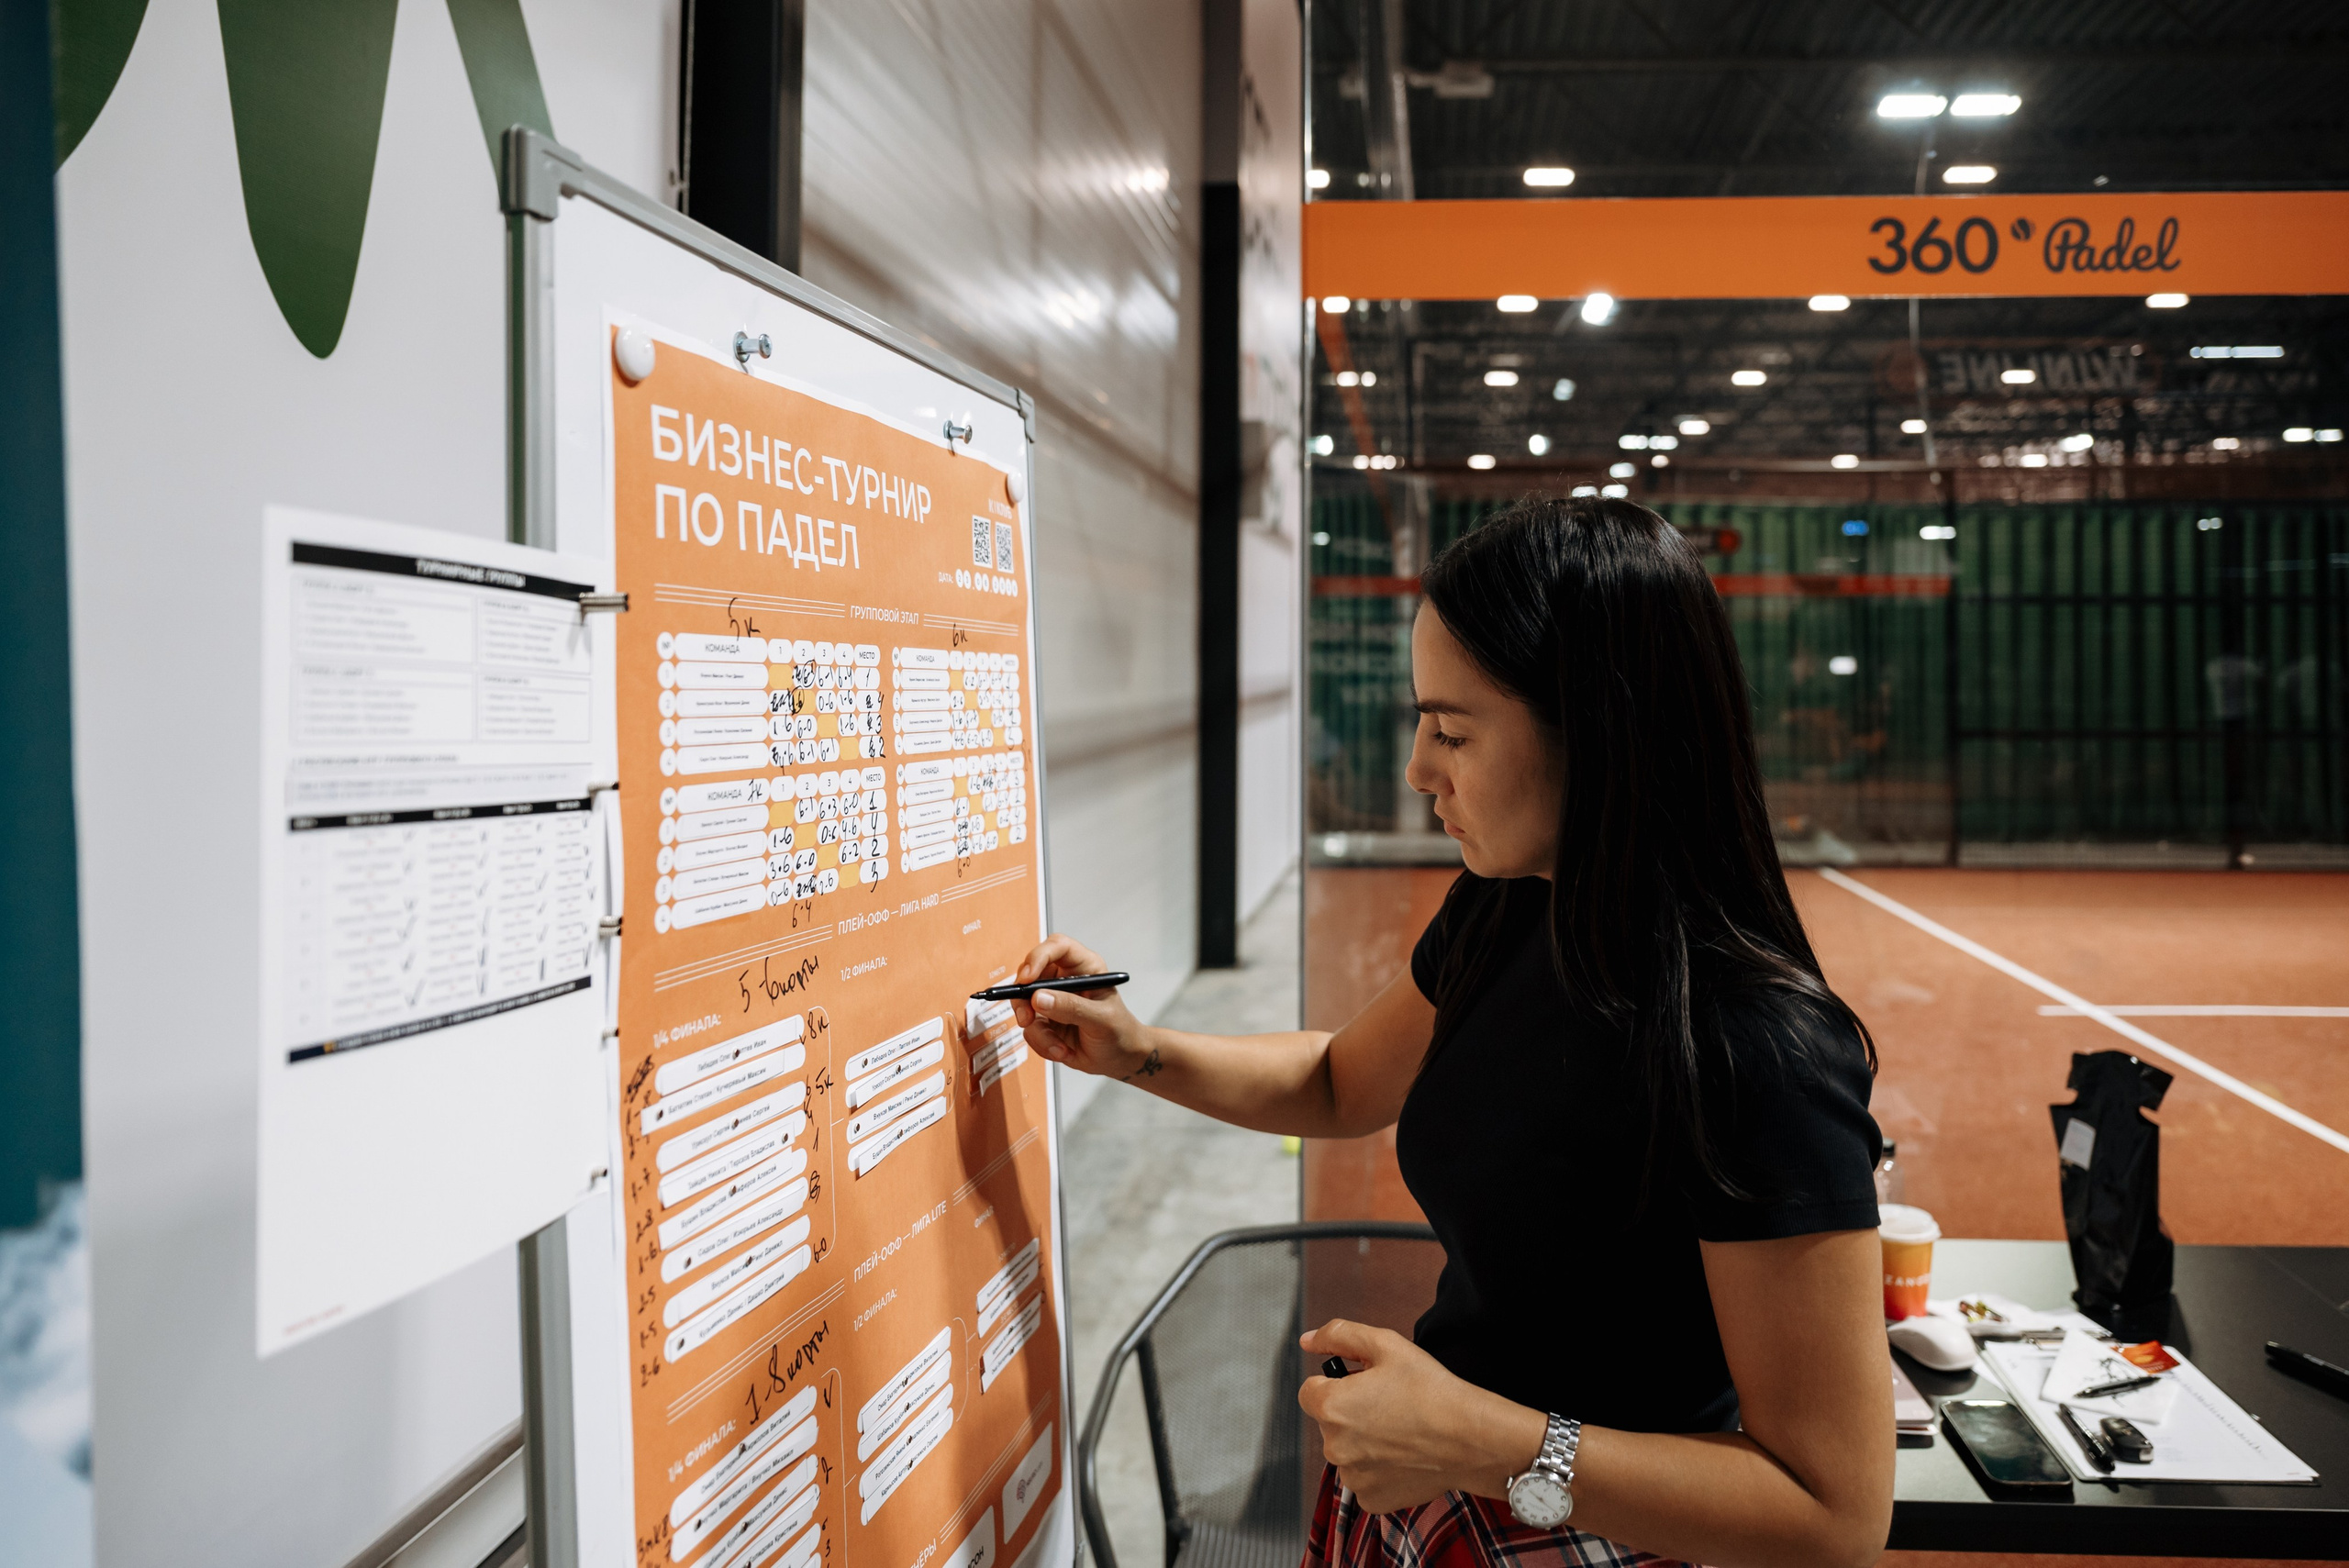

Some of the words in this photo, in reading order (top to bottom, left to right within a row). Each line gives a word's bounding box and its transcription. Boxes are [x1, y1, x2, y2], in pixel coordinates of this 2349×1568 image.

[1868, 216, 1999, 274] 360
[2043, 217, 2182, 273] Padel
[650, 404, 932, 524] БИЗНЕС-ТУРНИР
[655, 484, 724, 547] ПО
[738, 501, 860, 572] ПАДЕЛ
[851, 606, 899, 623] ГРУППОВОЙ
[900, 612, 919, 625] ЭТАП
[705, 643, 740, 654] КОМАНДА
[801, 648, 806, 657] 2
[822, 649, 827, 658] 3
[859, 651, 875, 660] МЕСТО
[916, 654, 935, 662] КОМАНДА
[920, 766, 940, 775] КОМАНДА
[707, 789, 742, 801] КОМАНДА
[805, 782, 809, 790] 2
[865, 773, 881, 783] МЕСТО
[872, 839, 880, 857] 2
[838, 908, 889, 936] ПЛЕЙ-ОФФ
[899, 900, 919, 917] ЛИГА
[921, 893, 940, 910] HARD
[841, 968, 852, 982] 1/2
[852, 956, 887, 977] ФИНАЛА:
[653, 1029, 669, 1049] 1/4
[670, 1014, 722, 1043] ФИНАЛА:
[909, 1057, 922, 1067] Сергей
[747, 1068, 766, 1080] Максим
[752, 1104, 770, 1118] Сергей
[887, 1101, 902, 1111] Максим
[919, 1111, 935, 1124] Алексей
[751, 1140, 775, 1158] Владислав
[757, 1163, 777, 1180] Алексей
[757, 1208, 784, 1225] Александр
[853, 1236, 902, 1284] ПЛЕЙ-ОФФ
[911, 1213, 931, 1239] ЛИГА
[931, 1200, 947, 1221] LITE
[764, 1272, 785, 1293] Дмитрий
[853, 1314, 863, 1331] 1/2
[863, 1288, 897, 1321] ФИНАЛА:
[923, 1348, 938, 1365] Виталий
[770, 1409, 791, 1431] Виталий
[667, 1460, 684, 1484] 1/4
[685, 1419, 737, 1467] ФИНАЛА:
[718, 1484, 748, 1509] Маргарита
[773, 1449, 794, 1468] Михаил
[774, 1520, 798, 1542] Кристина
